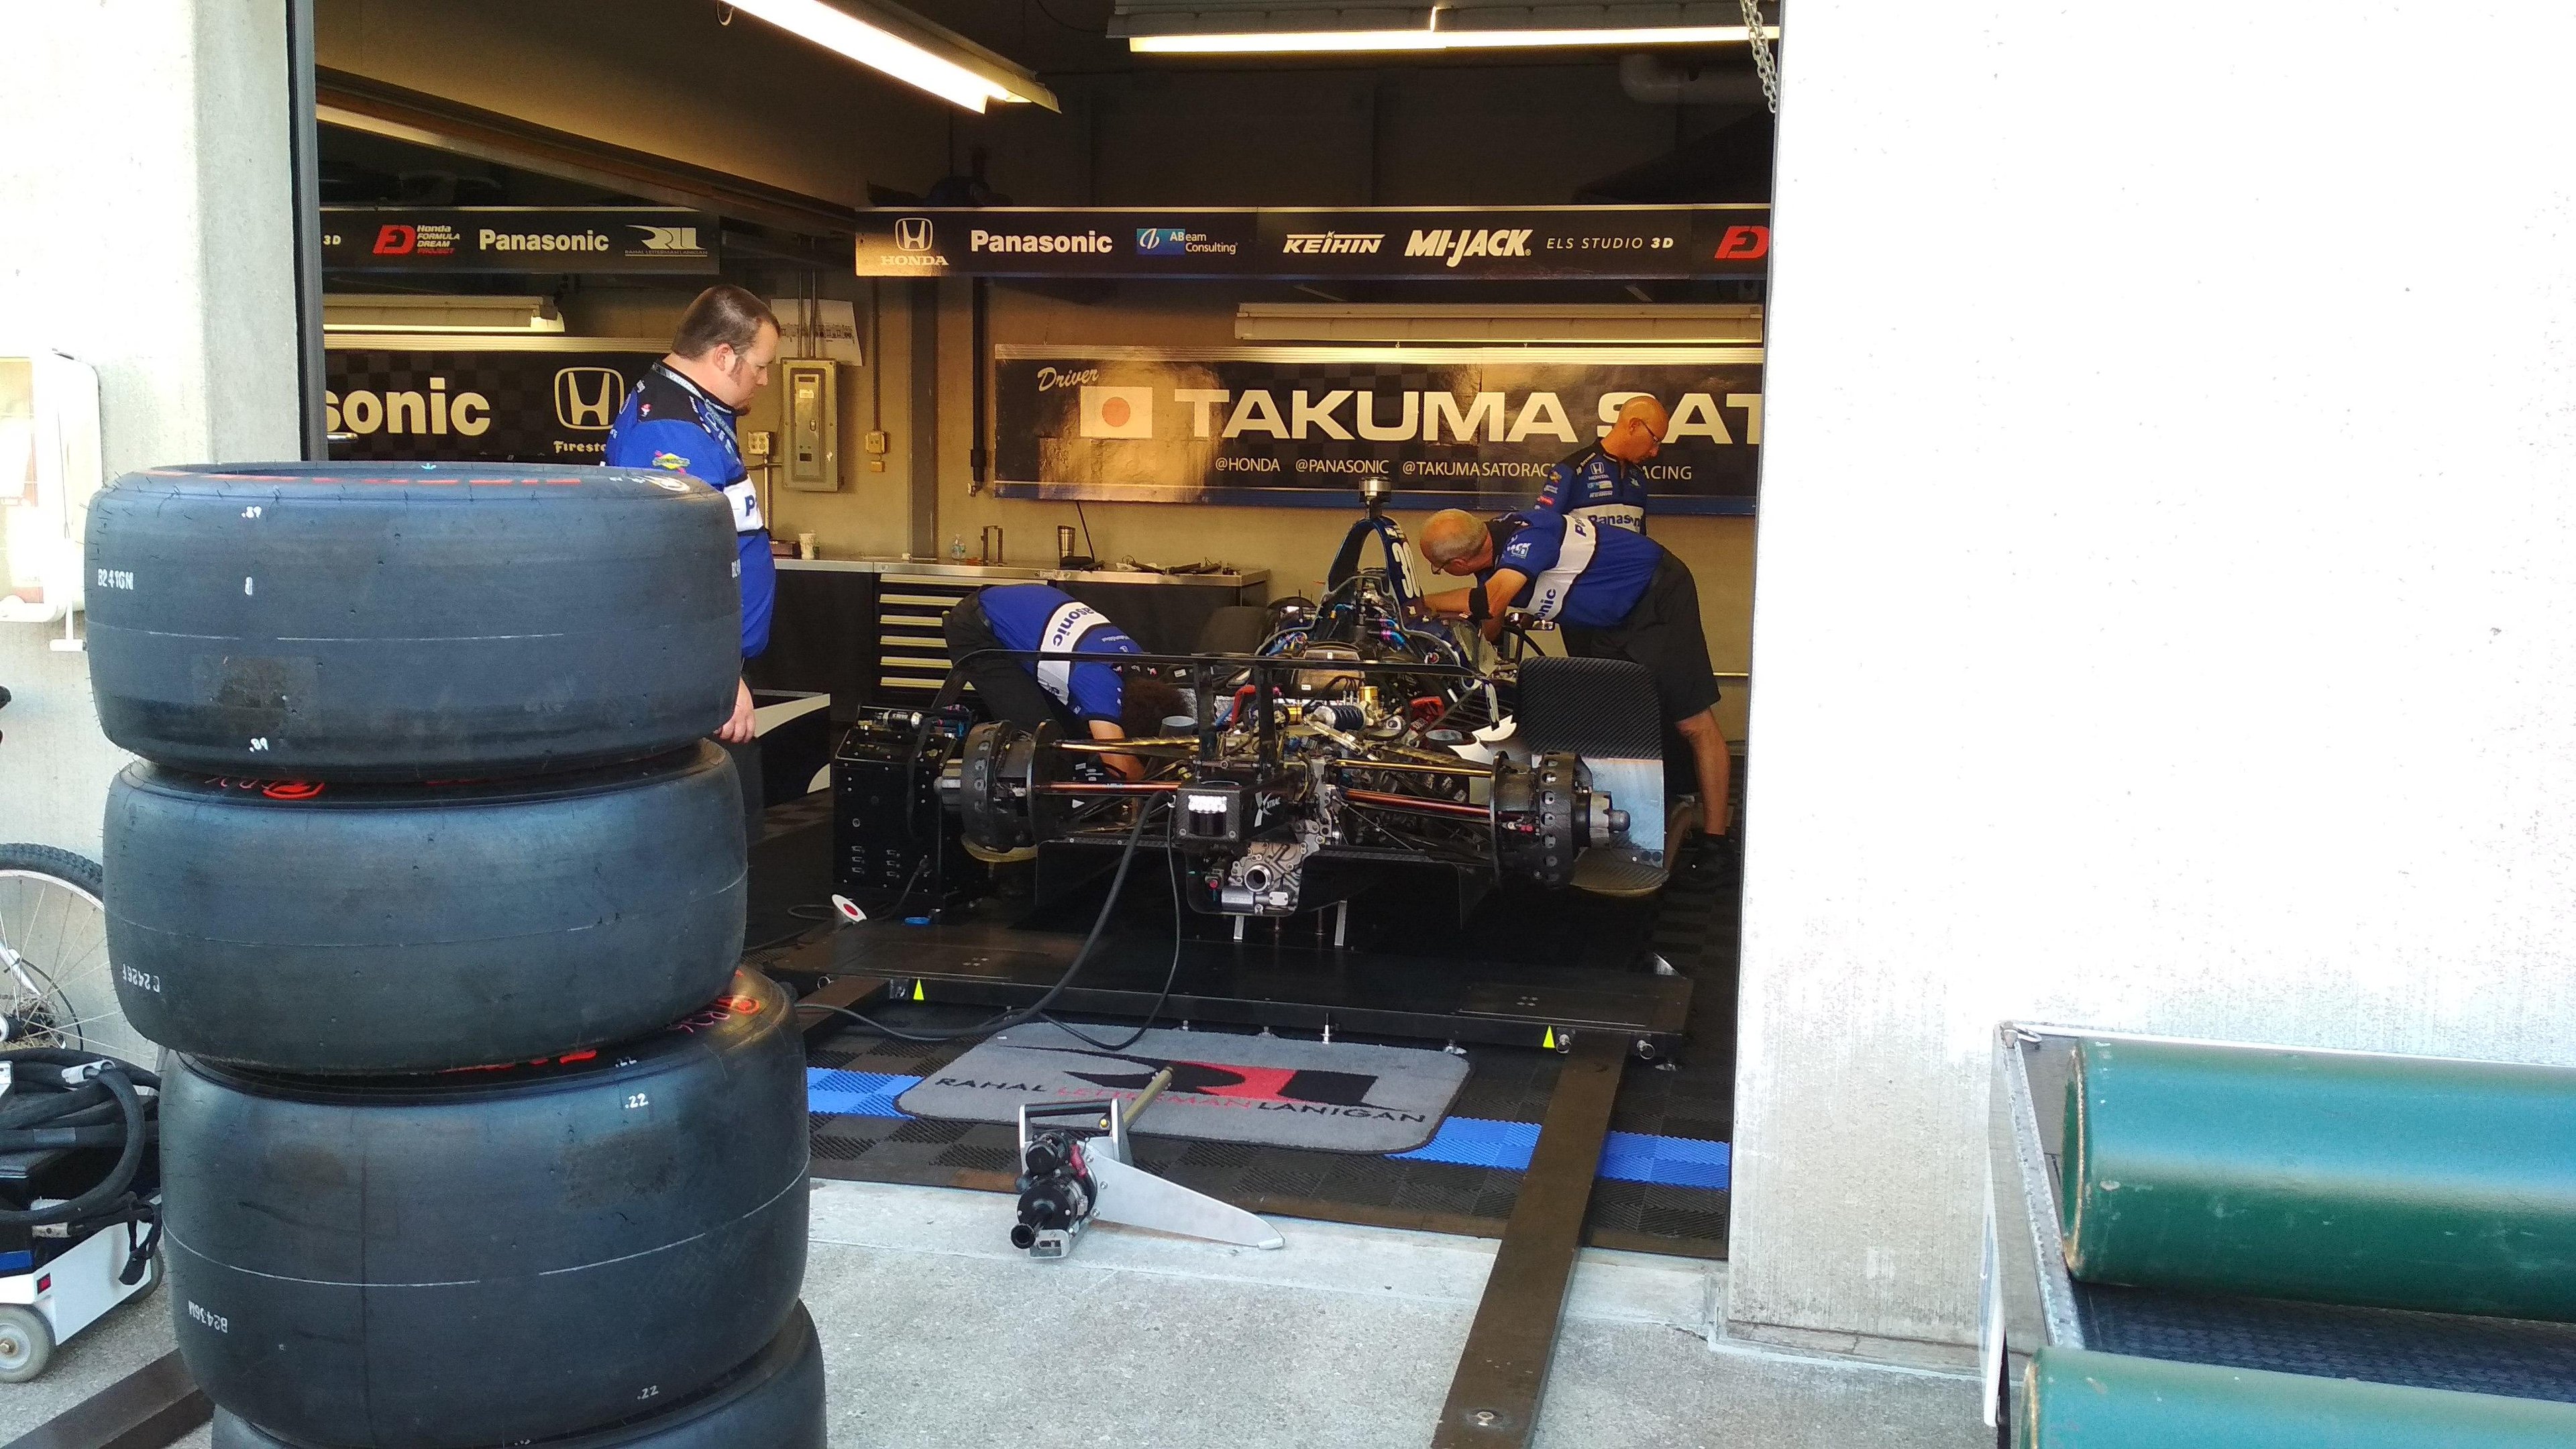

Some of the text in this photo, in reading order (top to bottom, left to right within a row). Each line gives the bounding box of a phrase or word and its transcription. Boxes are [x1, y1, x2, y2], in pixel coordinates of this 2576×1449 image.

[417, 225, 451, 233] Honda
[1169, 231, 1207, 242] ABeam
[479, 229, 609, 252] Panasonic
[971, 230, 1114, 254] Panasonic
[1185, 242, 1236, 254] Consulting
[1282, 231, 1383, 254] KEIHIN
[1546, 237, 1674, 249] ELS STUDIO 3D
[880, 256, 949, 266] HONDA
[1037, 366, 1099, 392] Driver
[1174, 389, 1579, 443] TAKUMA
[1215, 458, 1281, 472] @HONDA
[1295, 460, 1389, 474] @PANASONIC
[1403, 462, 1556, 478] @TAKUMASATORAC
[1391, 541, 1421, 599] 30
[625, 1093, 649, 1109] .22
[934, 1077, 1047, 1092] RAHAL
[1257, 1101, 1426, 1124] LANIGAN
[637, 1385, 659, 1400] .22
